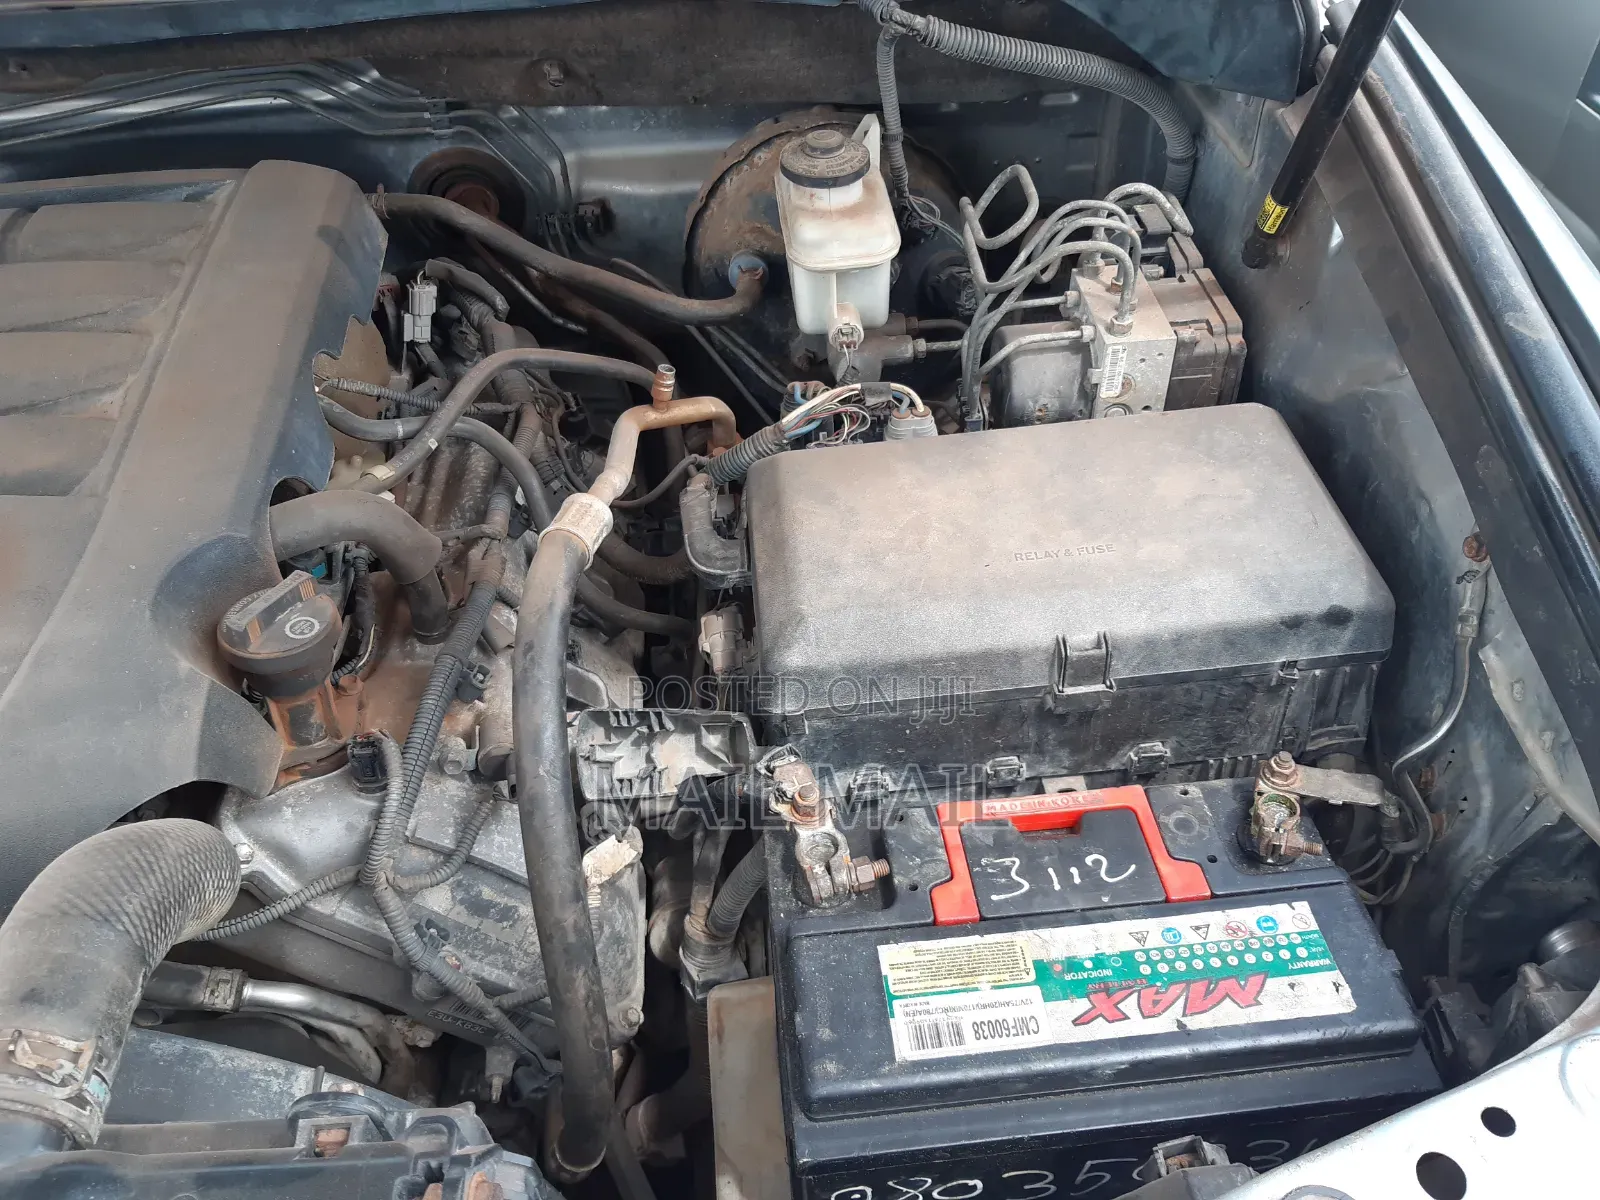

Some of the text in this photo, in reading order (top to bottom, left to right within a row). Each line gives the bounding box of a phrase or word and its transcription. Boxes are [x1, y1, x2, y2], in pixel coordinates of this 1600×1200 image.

[1013, 543, 1117, 562] RELAY & FUSE
[1287, 957, 1331, 969] WARRANTY
[1063, 968, 1113, 980] INDICATOR
[1072, 972, 1269, 1026] MAX
[972, 1015, 1040, 1041] CMF60038
